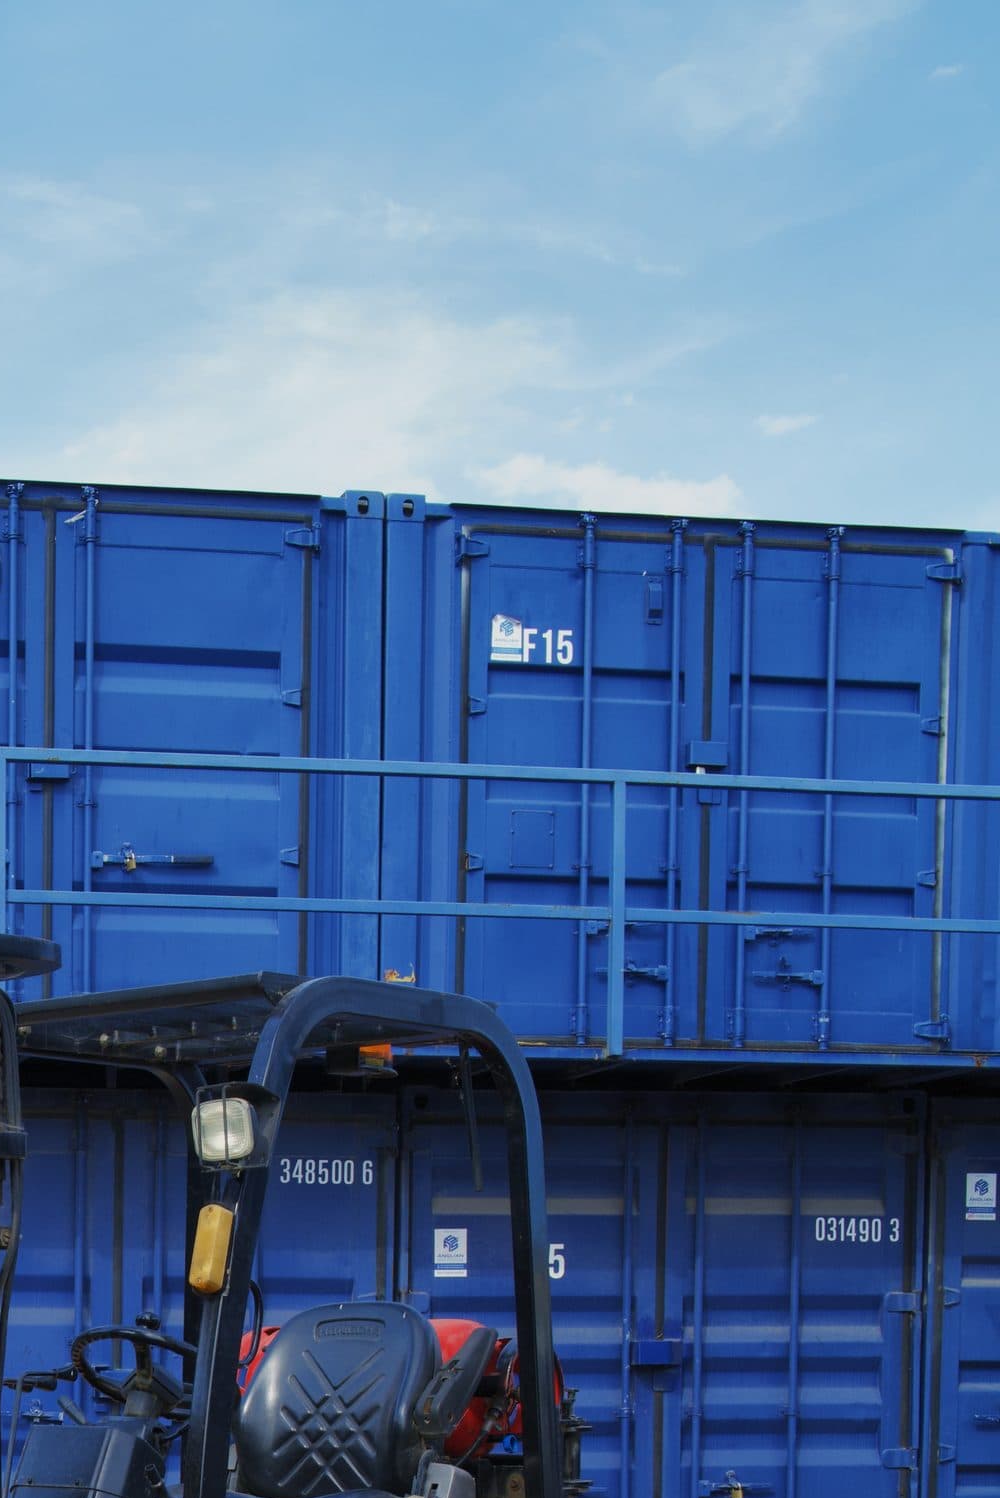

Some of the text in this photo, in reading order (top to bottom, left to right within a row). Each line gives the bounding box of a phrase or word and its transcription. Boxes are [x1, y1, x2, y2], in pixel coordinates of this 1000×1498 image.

[523, 628, 574, 664] F15
[280, 1158, 373, 1185] 348500 6
[815, 1217, 900, 1242] 031490 3
